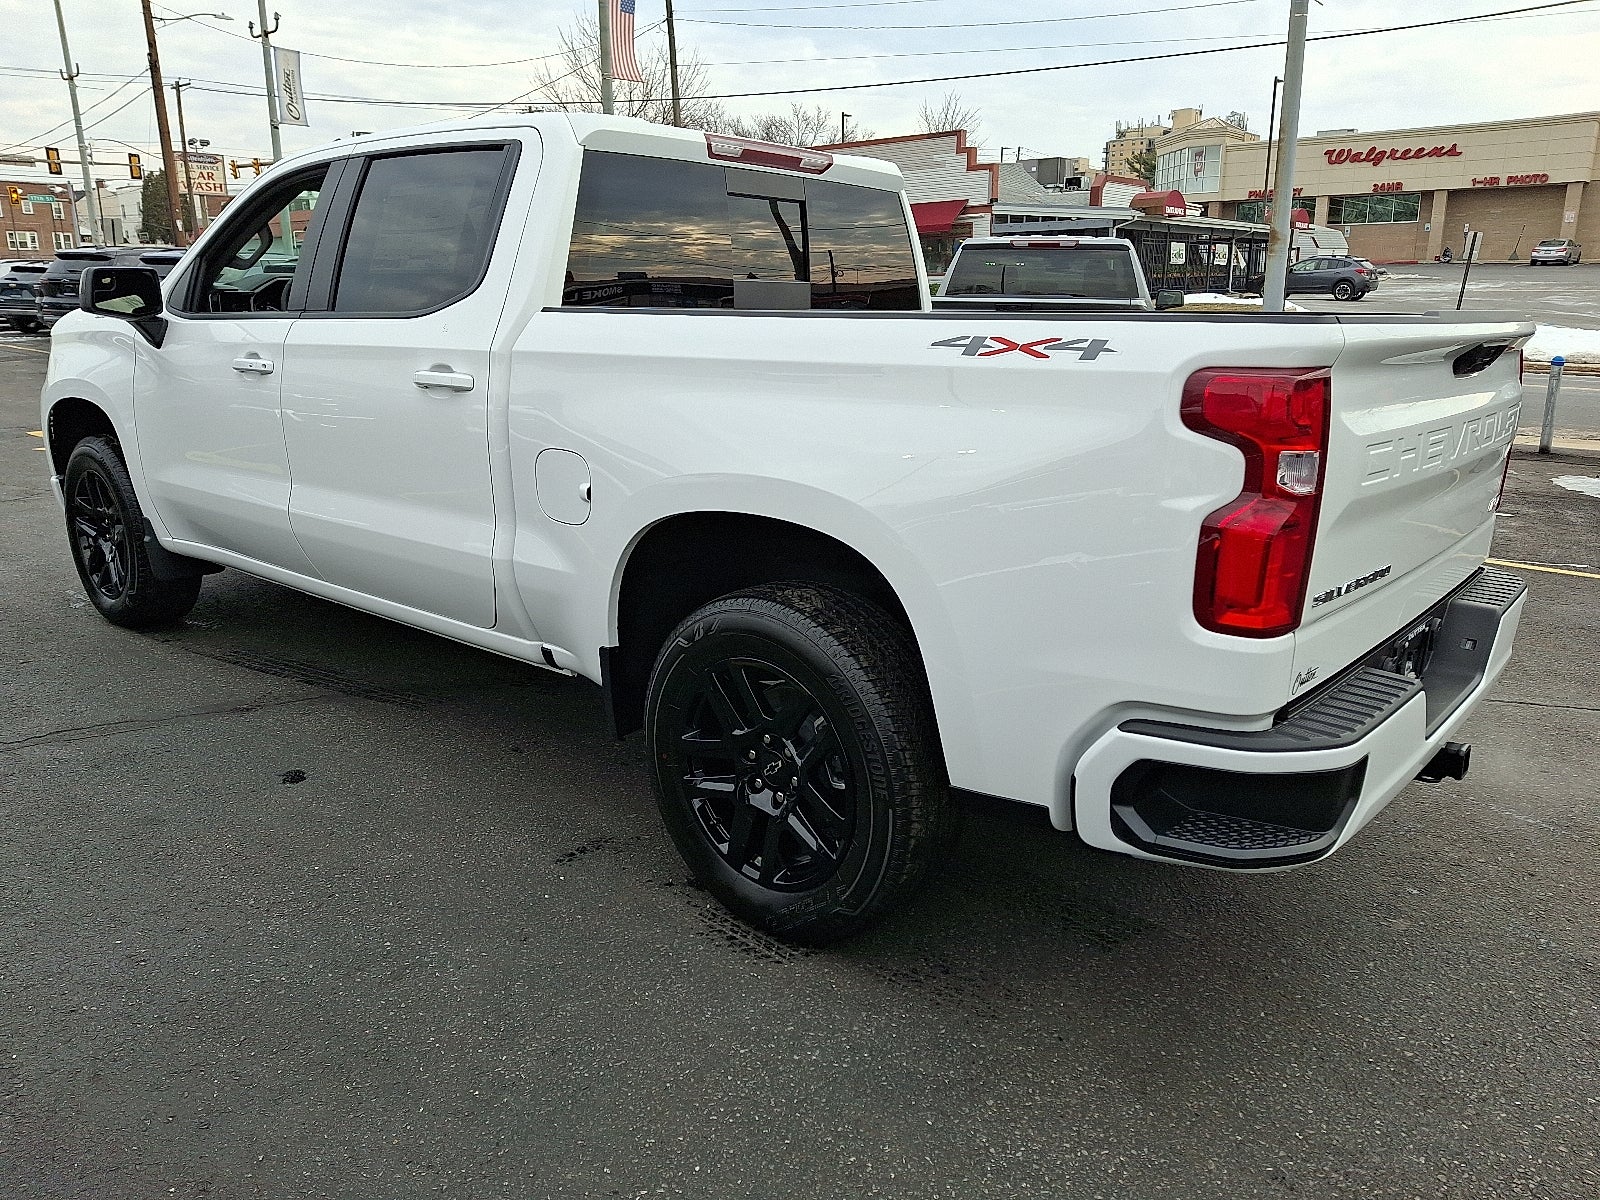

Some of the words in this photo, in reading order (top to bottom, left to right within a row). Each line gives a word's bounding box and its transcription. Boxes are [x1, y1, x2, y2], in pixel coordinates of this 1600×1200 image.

[283, 68, 300, 120] Outten
[1323, 143, 1463, 167] Walgreens
[1372, 182, 1403, 192] 24HR
[1471, 177, 1500, 186] 1-HR
[1506, 173, 1549, 185] PHOTO
[1361, 401, 1522, 486] CHEVROLET
